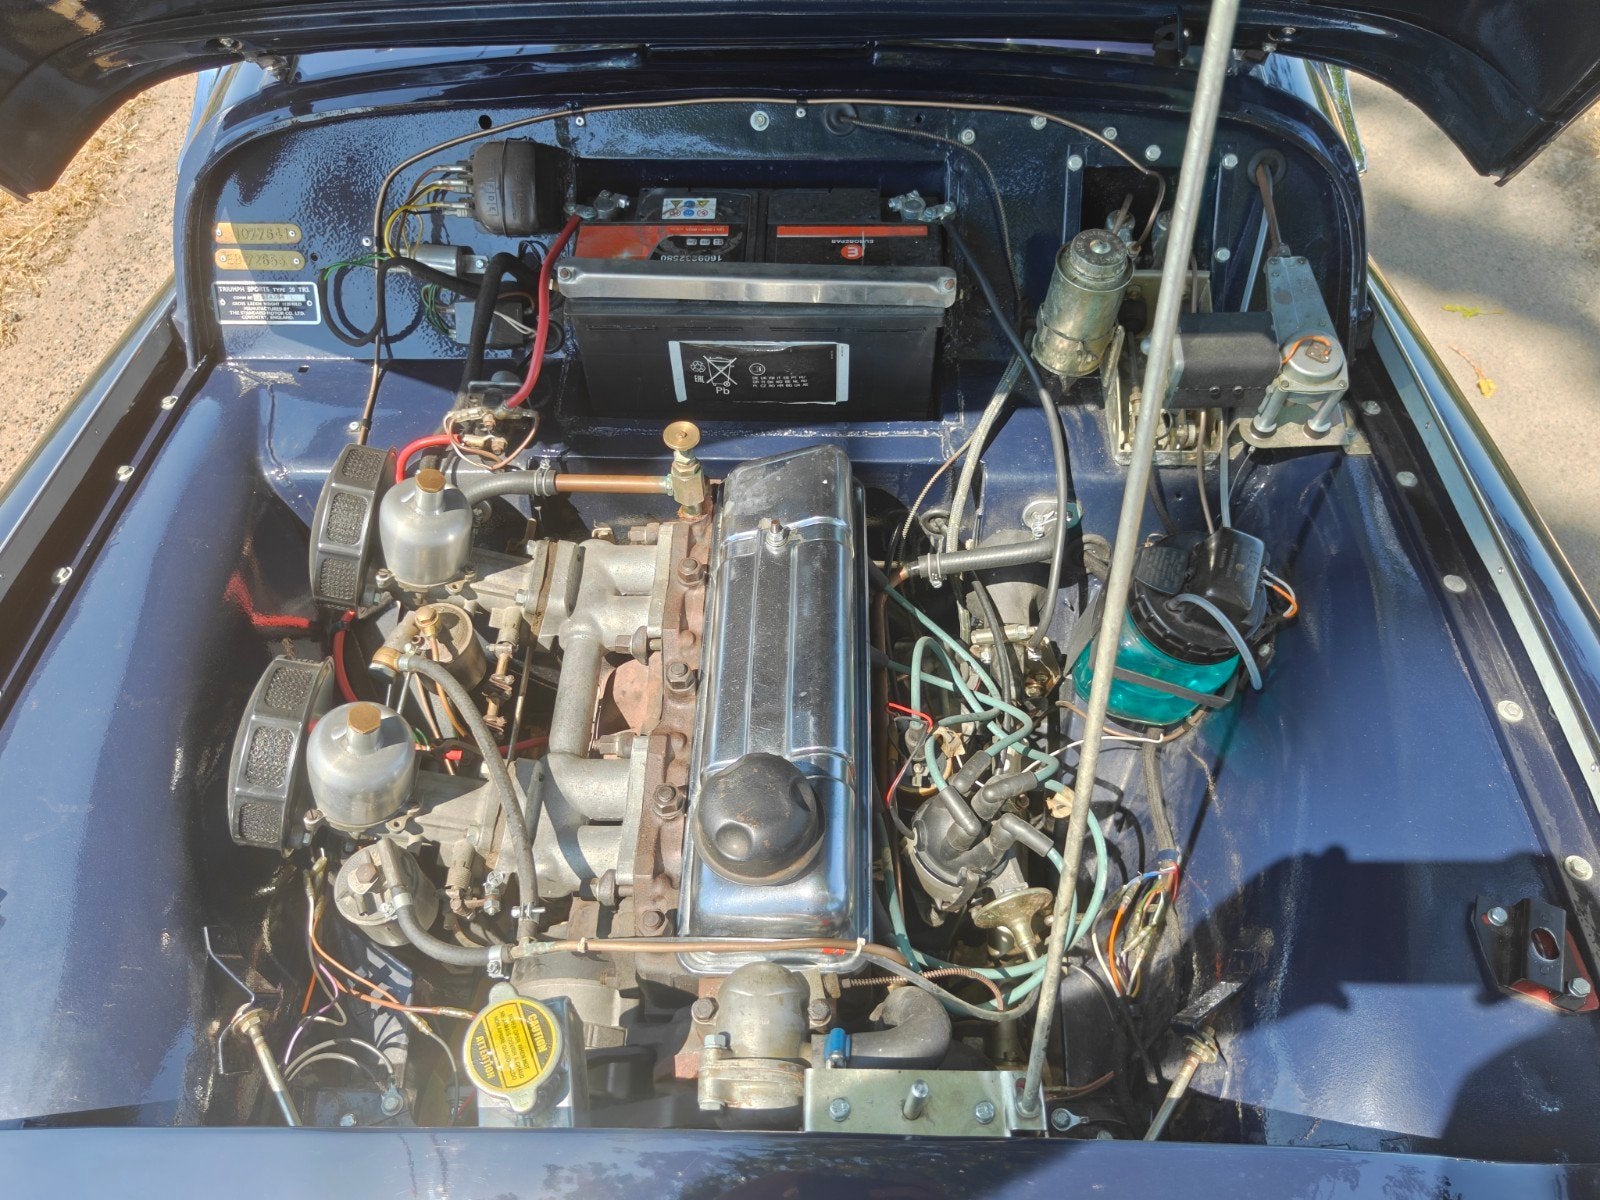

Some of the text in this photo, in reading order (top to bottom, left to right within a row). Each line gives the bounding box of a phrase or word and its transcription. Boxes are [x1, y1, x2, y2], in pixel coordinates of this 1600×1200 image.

[715, 387, 731, 395] Pb
[528, 1013, 548, 1053] CAUTION
[475, 1035, 496, 1079] ATTENTION
[518, 1043, 526, 1059] WHEN
